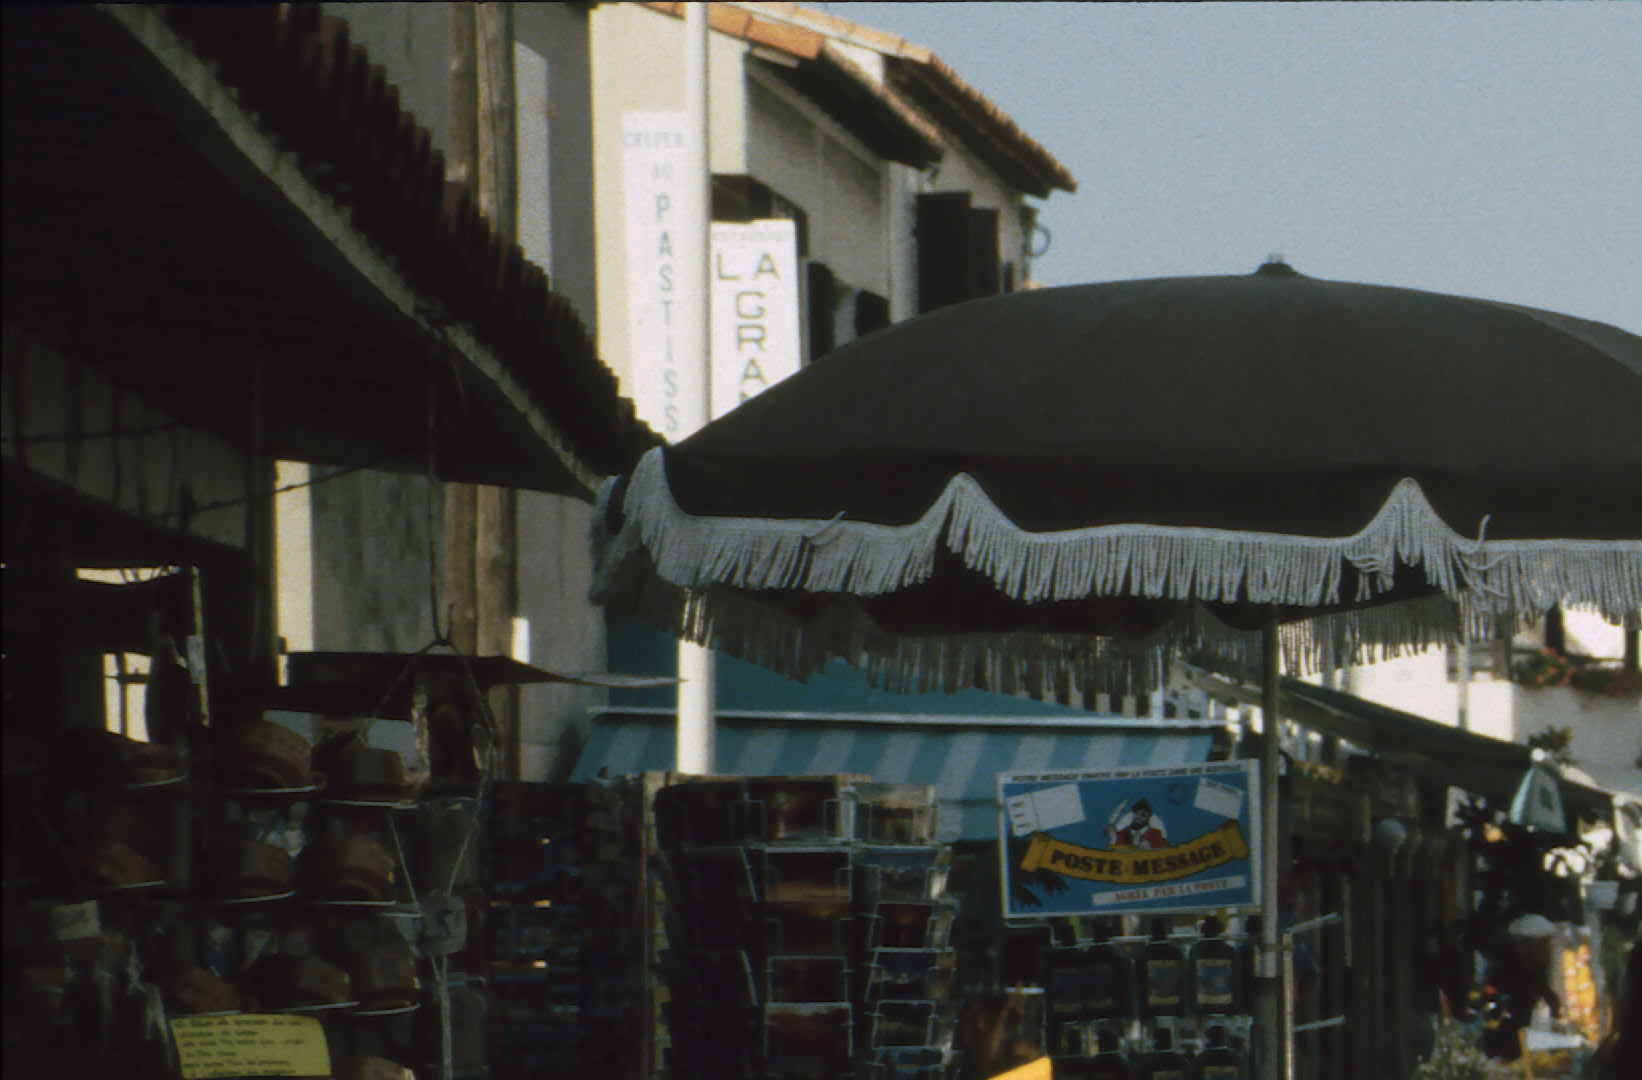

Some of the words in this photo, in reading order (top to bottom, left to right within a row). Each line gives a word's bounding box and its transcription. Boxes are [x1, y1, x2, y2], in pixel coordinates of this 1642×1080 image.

[717, 253, 782, 281] LA
[1051, 850, 1122, 876] POSTE
[1132, 840, 1226, 876] MESSAGE
[1154, 885, 1176, 897] PAR
[1195, 879, 1229, 892] POSTE
